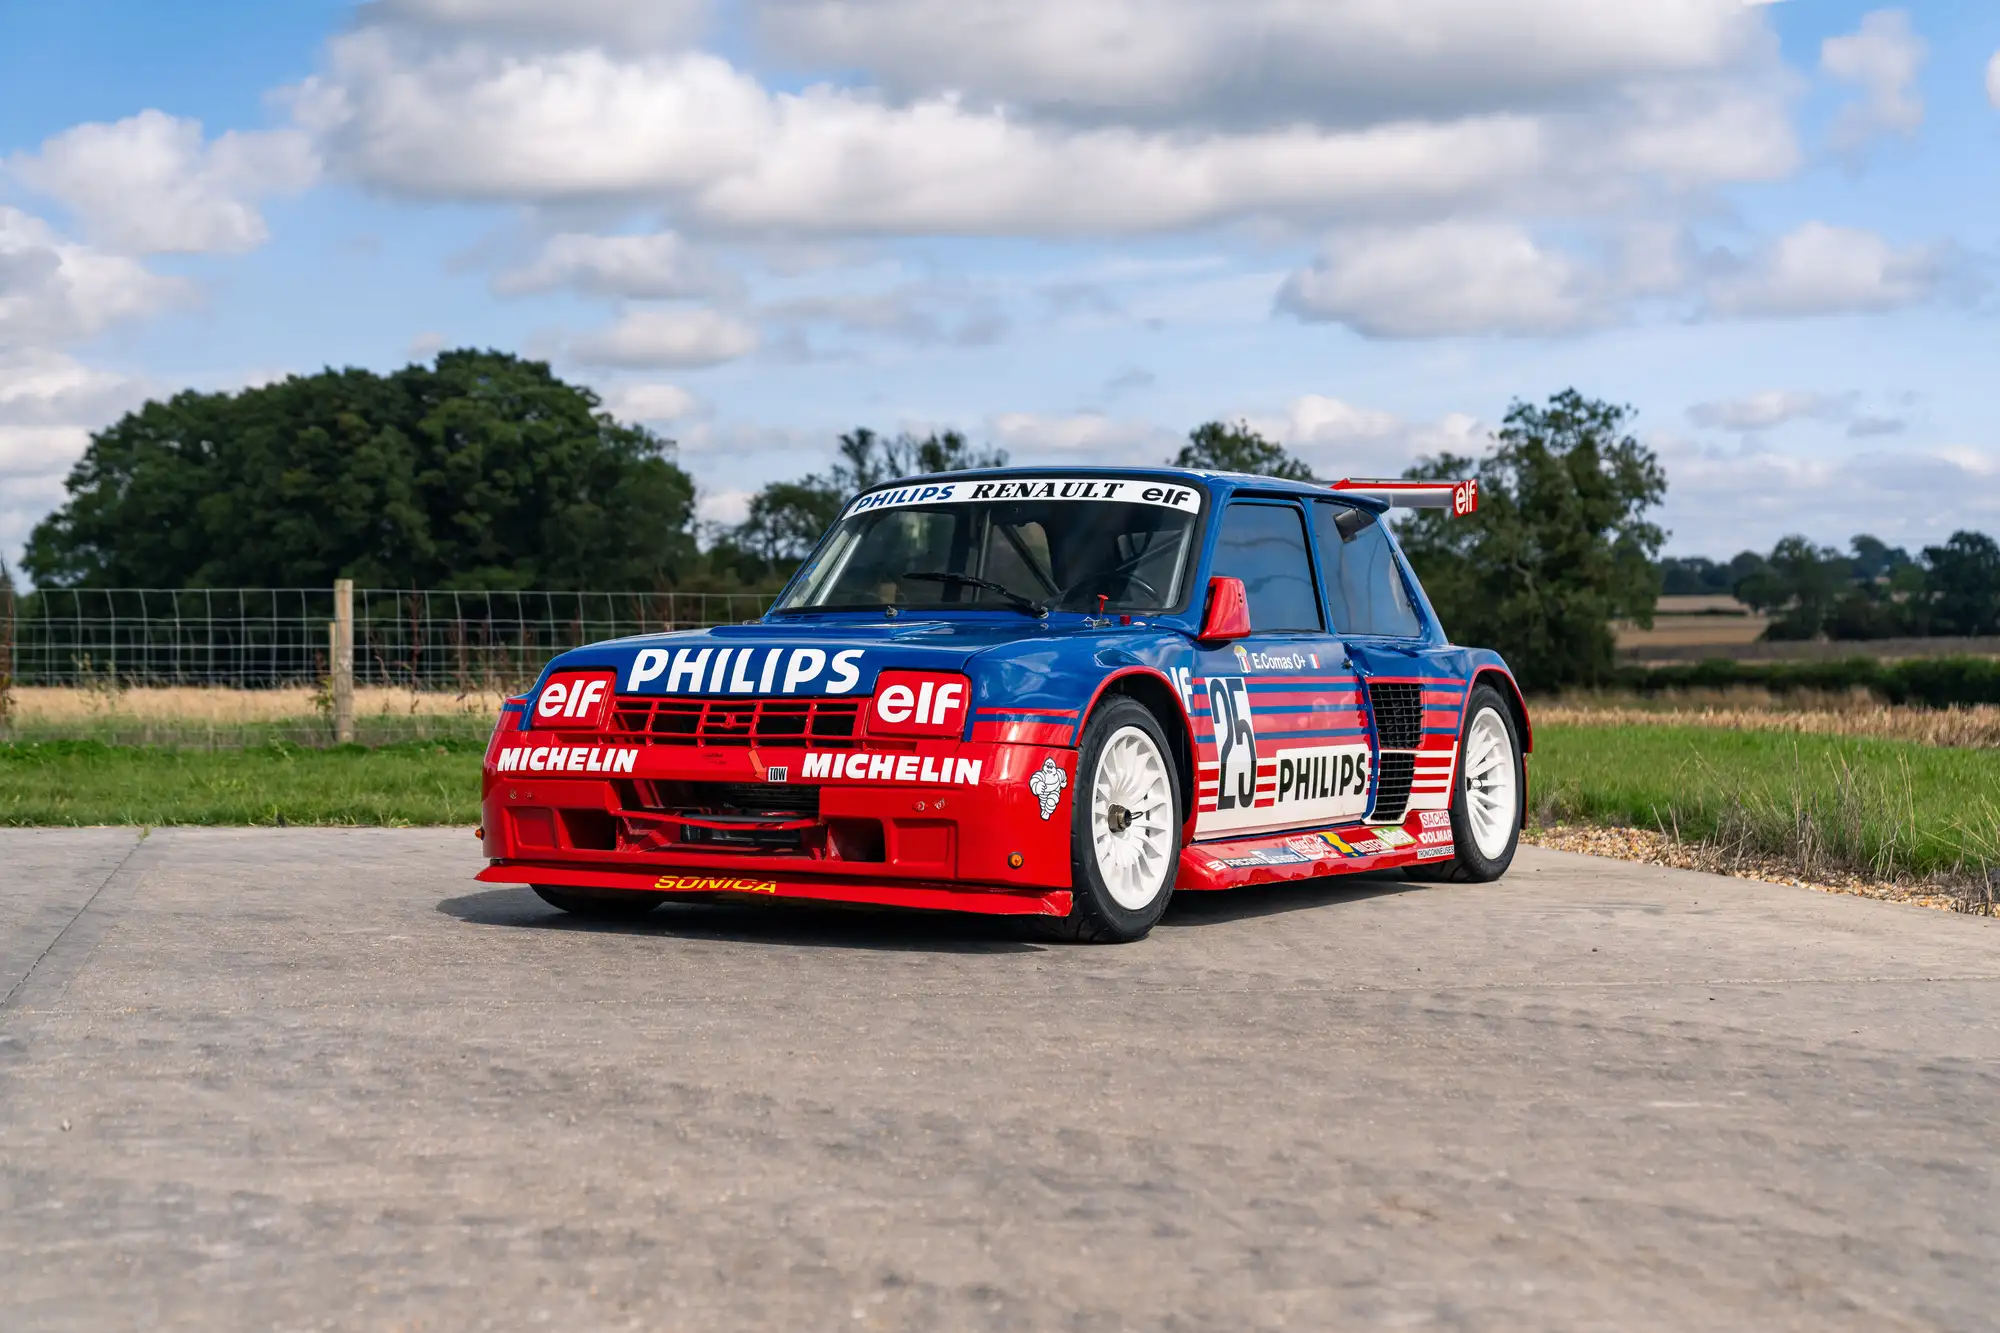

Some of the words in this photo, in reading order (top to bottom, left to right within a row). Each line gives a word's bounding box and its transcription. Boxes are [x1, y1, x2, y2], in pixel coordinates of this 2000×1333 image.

[854, 485, 956, 514] PHILIPS
[968, 482, 1124, 500] RENAULT
[1142, 487, 1191, 508] elf
[1455, 479, 1477, 515] elf
[627, 648, 865, 694] PHILIPS
[1252, 652, 1293, 670] E.Comas
[538, 679, 607, 719] elf
[876, 682, 962, 725] elf
[497, 747, 639, 773] MICHELIN
[1209, 677, 1257, 810] 25
[769, 767, 787, 781] TOW
[801, 752, 983, 786] MICHELIN
[1278, 752, 1367, 803] PHILIPS
[1421, 811, 1450, 826] SACHS
[1419, 830, 1453, 844] DOLMAR
[654, 875, 776, 894] SONICA
